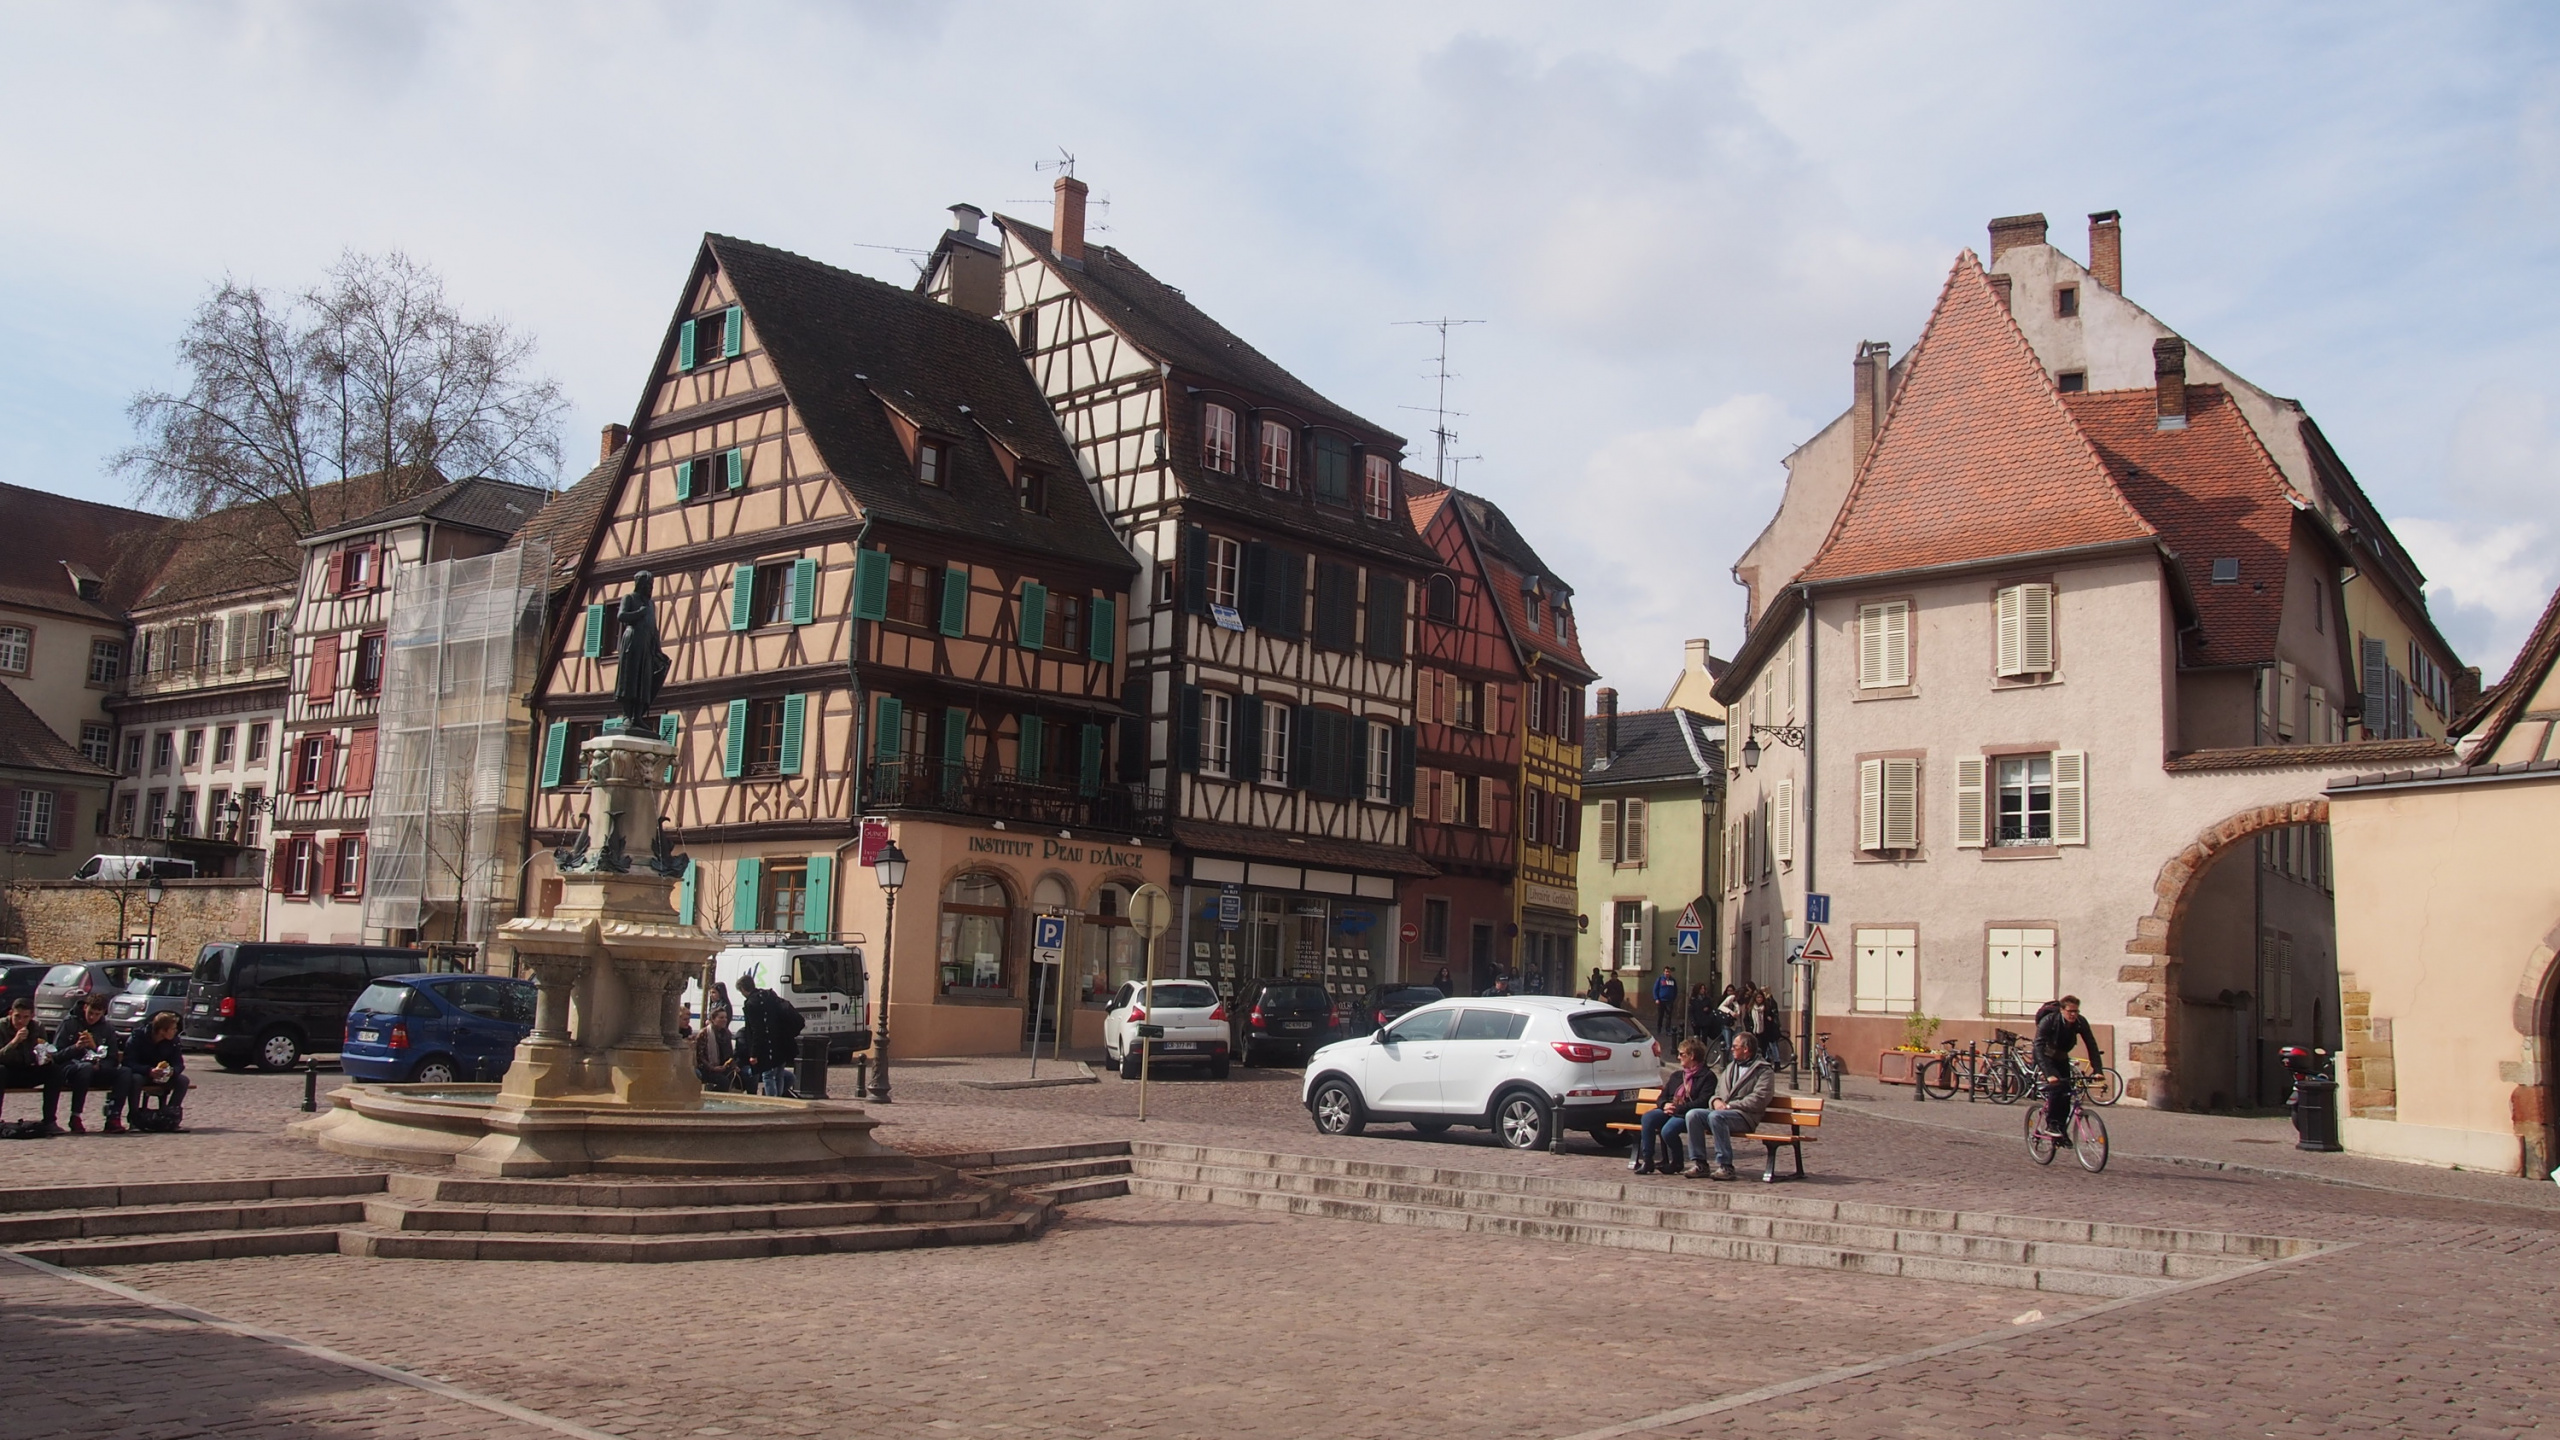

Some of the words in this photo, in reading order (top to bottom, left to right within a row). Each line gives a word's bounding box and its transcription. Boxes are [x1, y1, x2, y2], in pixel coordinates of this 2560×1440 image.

[864, 828, 887, 838] GUINOT
[969, 836, 1034, 857] INSTITUT
[1043, 838, 1083, 862] PEAU
[1089, 846, 1143, 869] D'ANGE
[1529, 887, 1551, 902] Librairie
[1044, 923, 1058, 943] P
